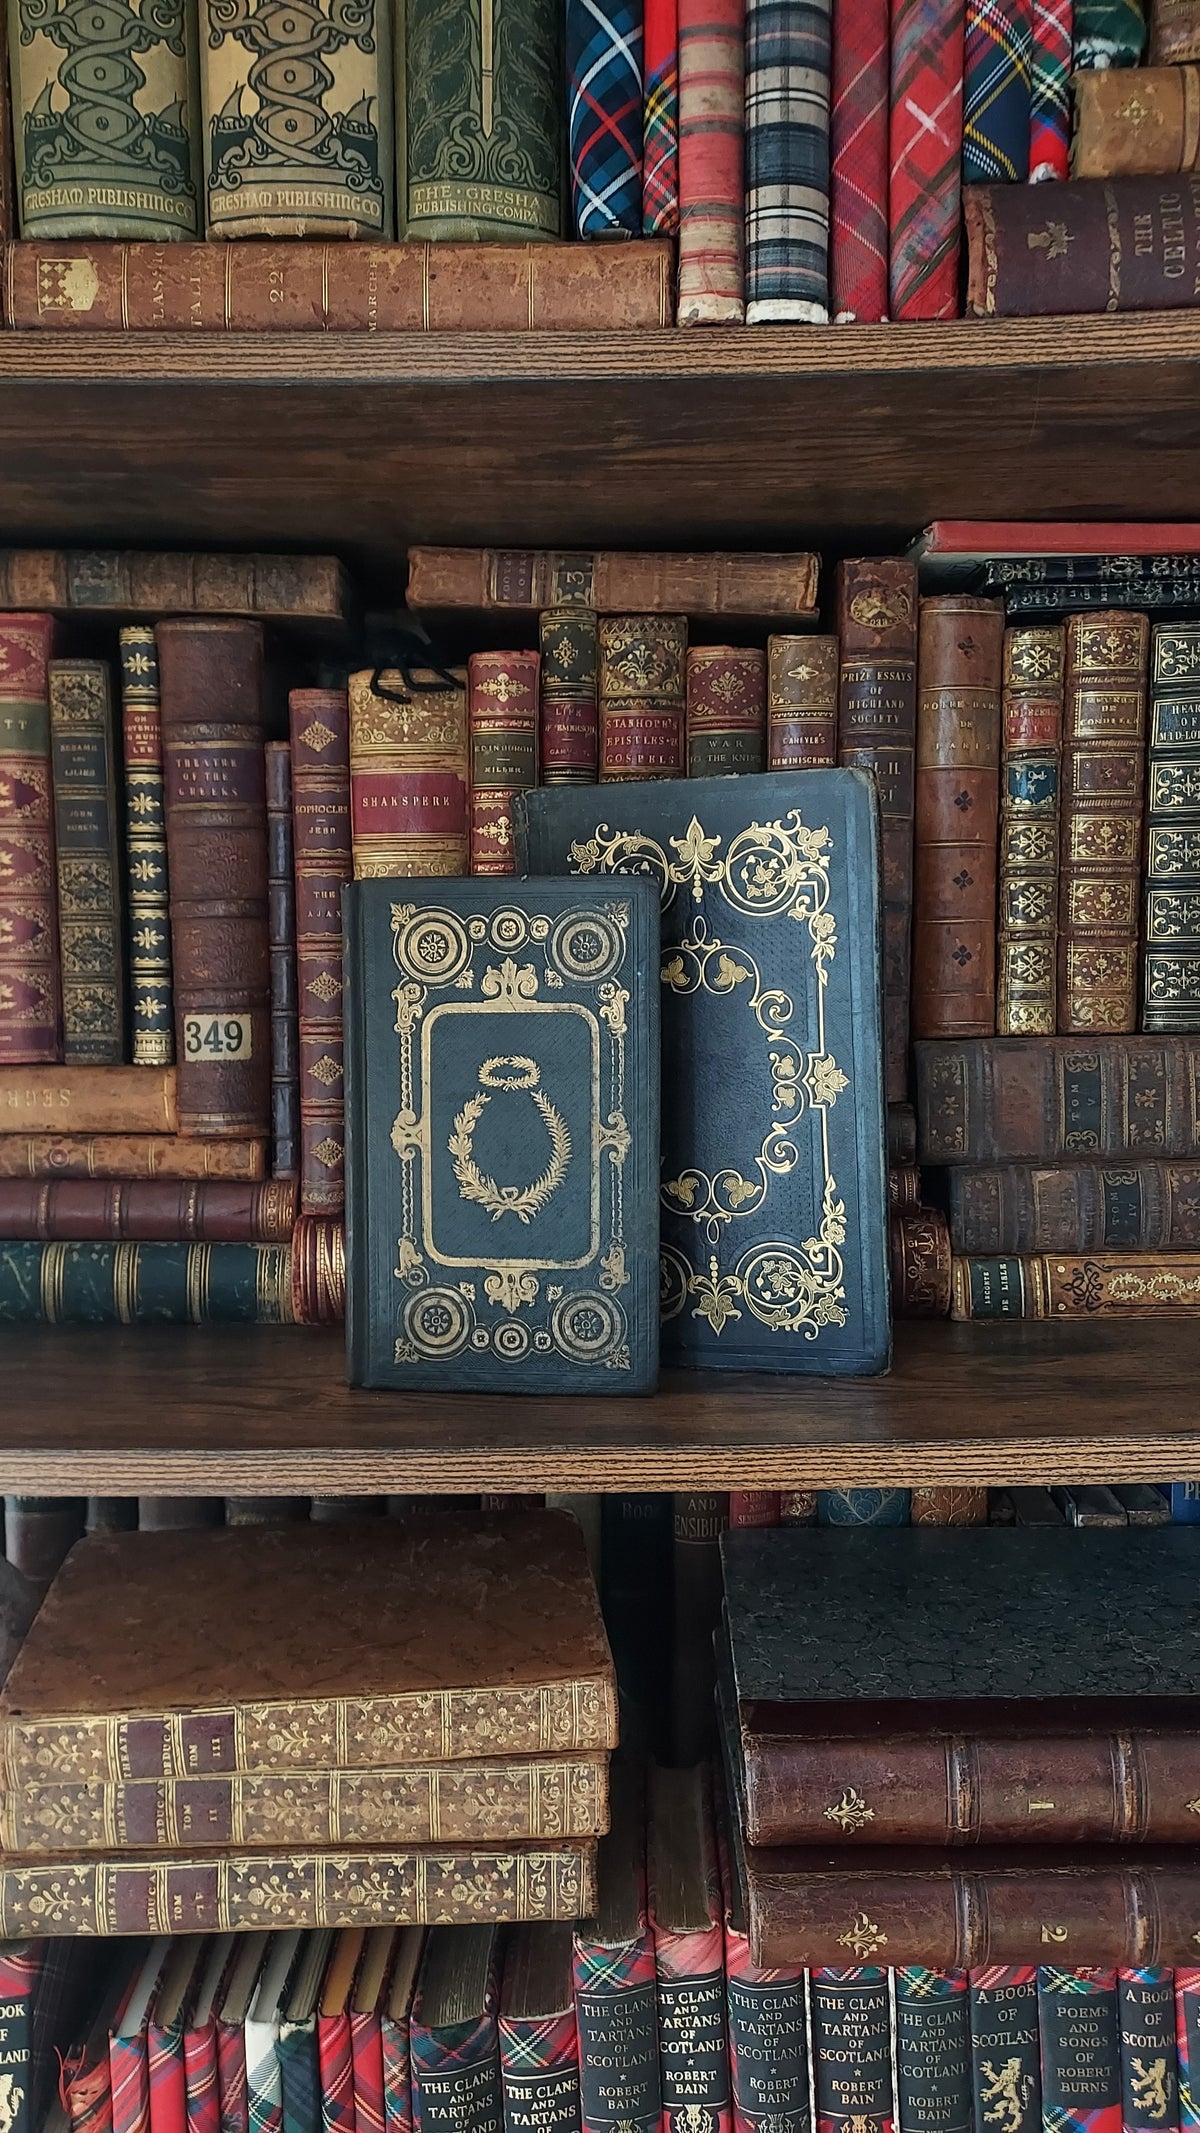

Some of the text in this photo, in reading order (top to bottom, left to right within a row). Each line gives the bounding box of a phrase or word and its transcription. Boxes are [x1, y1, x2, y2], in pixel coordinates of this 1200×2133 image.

[25, 188, 84, 210] GRESHAM
[87, 188, 174, 213] PUBLISHING
[413, 185, 541, 209] THE GRESHA
[211, 191, 380, 217] GRESHAM PUBLISHING CO
[1133, 213, 1154, 257] THE
[1160, 192, 1186, 279] CELTIC
[842, 669, 912, 682] PRIZE ESSAYS
[870, 686, 884, 695] OF
[848, 700, 905, 710] HIGHLAND
[851, 714, 900, 724] SOCIETY
[1181, 717, 1198, 727] OF
[709, 740, 743, 748] WAR
[176, 759, 237, 768] THEATRE
[707, 754, 727, 763] THE
[204, 772, 228, 781] THE
[362, 796, 450, 807] SHAKSPERE
[313, 891, 336, 899] THE
[186, 1020, 243, 1054] 349
[1071, 1084, 1080, 1122] TOM
[687, 1499, 717, 1511] AND
[211, 1738, 221, 1757] III
[188, 1744, 198, 1768] TOM
[183, 1804, 192, 1831] TOM
[209, 1808, 218, 1822] II
[173, 1894, 182, 1921] TOM
[1040, 1925, 1068, 1943] 2
[660, 1986, 722, 2005] HE CLANS
[975, 1983, 1037, 2004] A BOOK
[1126, 1988, 1138, 2003] A
[732, 1991, 759, 2010] THE
[817, 1995, 887, 2011] THE CLAN
[582, 2003, 610, 2017] THE
[673, 2005, 699, 2015] AND
[757, 2012, 783, 2021] AND
[997, 2008, 1018, 2022] OF
[1056, 2006, 1109, 2018] POEMS
[609, 2017, 633, 2027] AND
[660, 2013, 721, 2028] ARTANS
[843, 2012, 869, 2022] AND
[926, 2009, 968, 2026] CLAN
[1144, 2012, 1163, 2025] OF
[587, 2023, 653, 2042] TARTANS
[737, 2018, 803, 2036] TARTANS
[821, 2019, 888, 2037] TARTANS
[920, 2028, 946, 2038] AND
[1069, 2022, 1099, 2034] AND
[680, 2030, 696, 2039] OF
[971, 2028, 1038, 2048] SCOTLAN
[1121, 2031, 1176, 2048] SCOTLAN
[614, 2044, 628, 2053] OF
[660, 2038, 725, 2054] COTLAND
[763, 2038, 779, 2047] OF
[848, 2040, 864, 2049] OF
[900, 2036, 966, 2053] TARTANS
[1059, 2037, 1109, 2048] SONGS
[586, 2048, 656, 2068] SCOTLAND
[737, 2043, 806, 2062] SCOTLAND
[1075, 2052, 1095, 2063] OF
[925, 2055, 942, 2064] OF
[665, 2070, 717, 2081] ROBERT
[1056, 2067, 1113, 2078] ROBERT
[421, 2067, 496, 2094] THE CLANS
[749, 2077, 799, 2091] ROBERT
[831, 2079, 884, 2092] ROBERT
[1060, 2081, 1109, 2093] BURNS
[505, 2078, 579, 2100] THE CLANS
[598, 2081, 648, 2098] ROBERT
[674, 2083, 708, 2094] BAIN
[449, 2091, 474, 2104] AND
[607, 2097, 641, 2110] BAIN
[758, 2092, 790, 2104] BAIN
[841, 2094, 875, 2105] BAIN
[907, 2094, 960, 2107] ROBERT
[427, 2093, 494, 2119] TARTANS
[530, 2099, 556, 2111] AND
[510, 2104, 577, 2126] TARTANS
[917, 2109, 952, 2121] BAIN
[455, 2118, 470, 2129] OF
